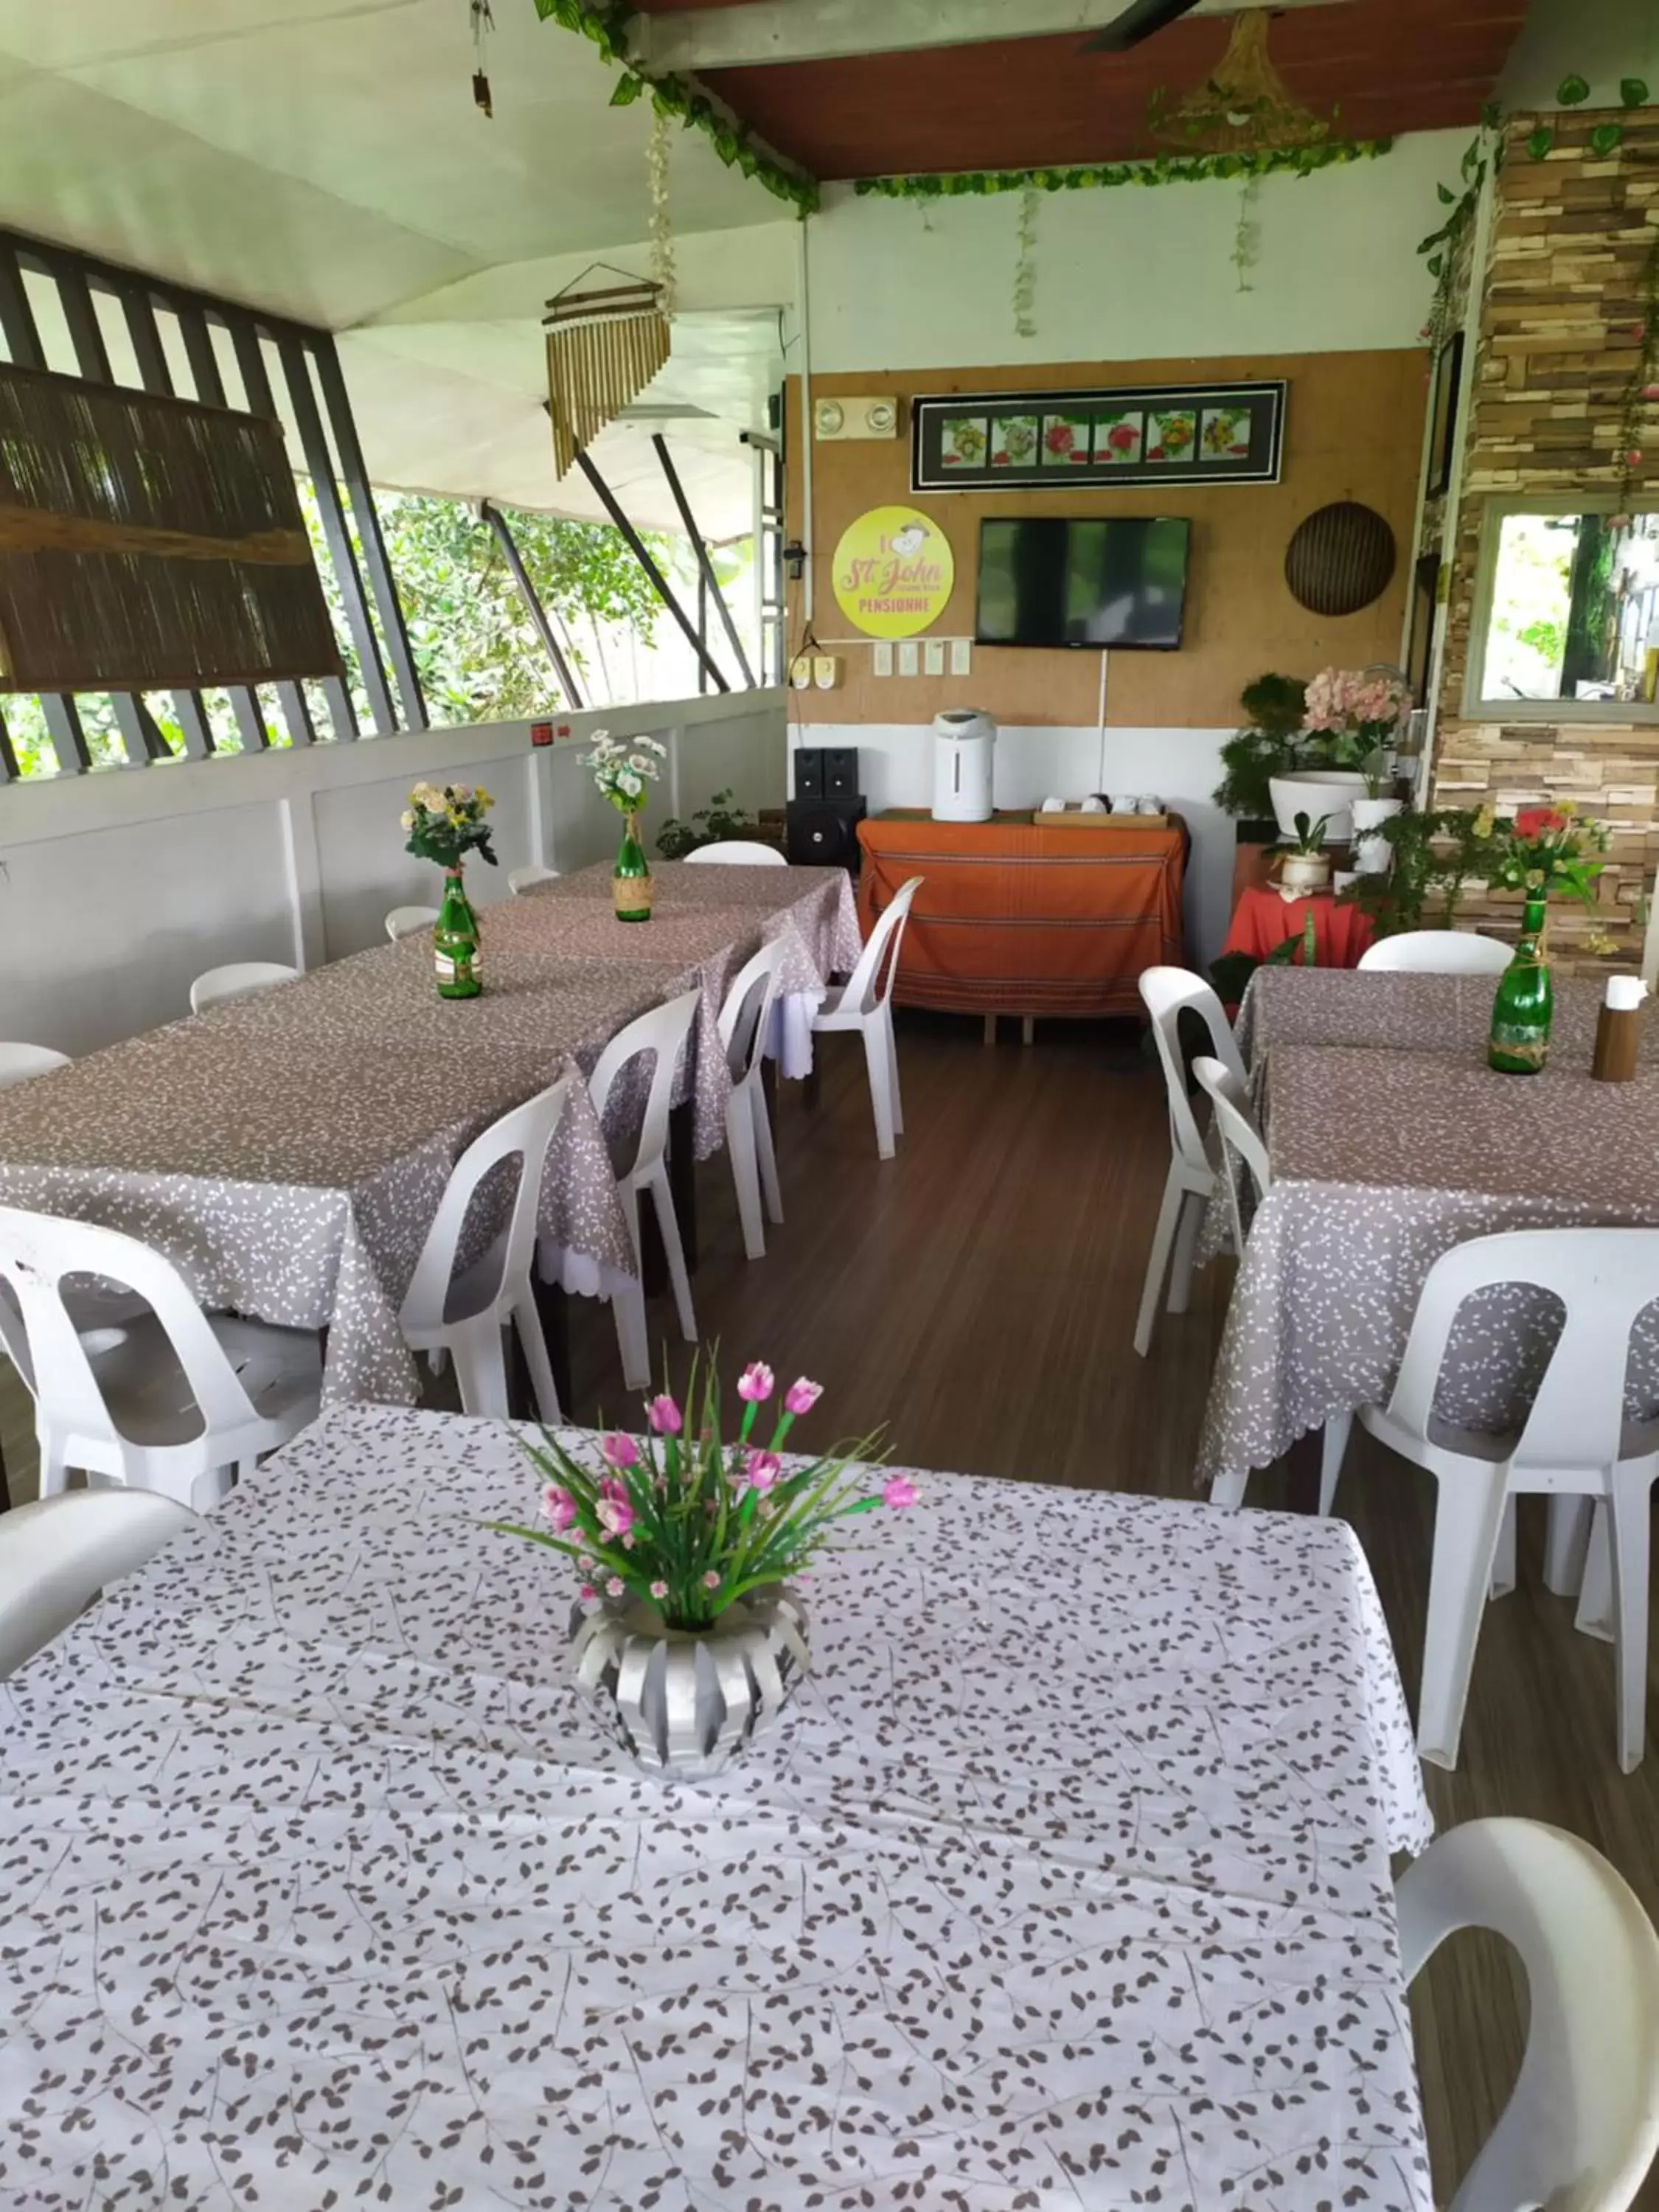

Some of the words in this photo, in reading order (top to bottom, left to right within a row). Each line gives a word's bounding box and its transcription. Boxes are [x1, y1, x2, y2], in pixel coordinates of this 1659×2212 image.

[880, 534, 886, 554] I
[878, 556, 944, 595] John
[859, 597, 928, 613] PENSIONNE
